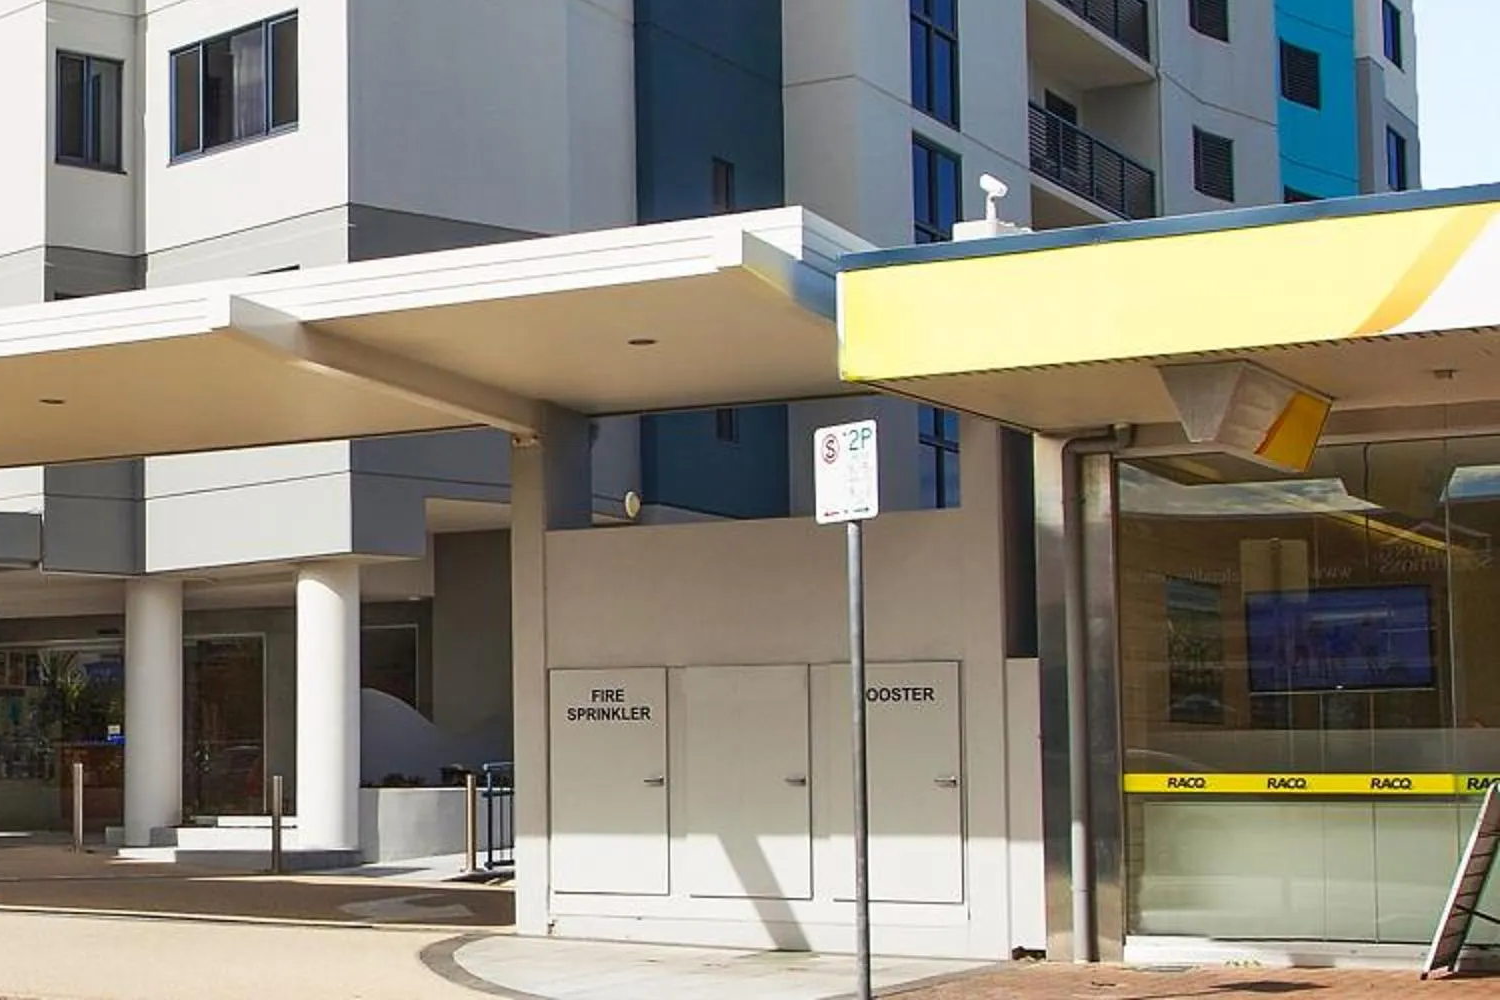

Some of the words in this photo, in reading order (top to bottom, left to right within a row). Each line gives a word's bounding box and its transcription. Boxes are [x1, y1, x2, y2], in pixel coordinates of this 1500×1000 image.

[591, 689, 625, 703] FIRE
[866, 687, 935, 702] OOSTER
[567, 706, 651, 721] SPRINKLER
[1167, 777, 1206, 789] RACQ
[1267, 777, 1307, 789] RACQ
[1370, 777, 1412, 790] RACQ
